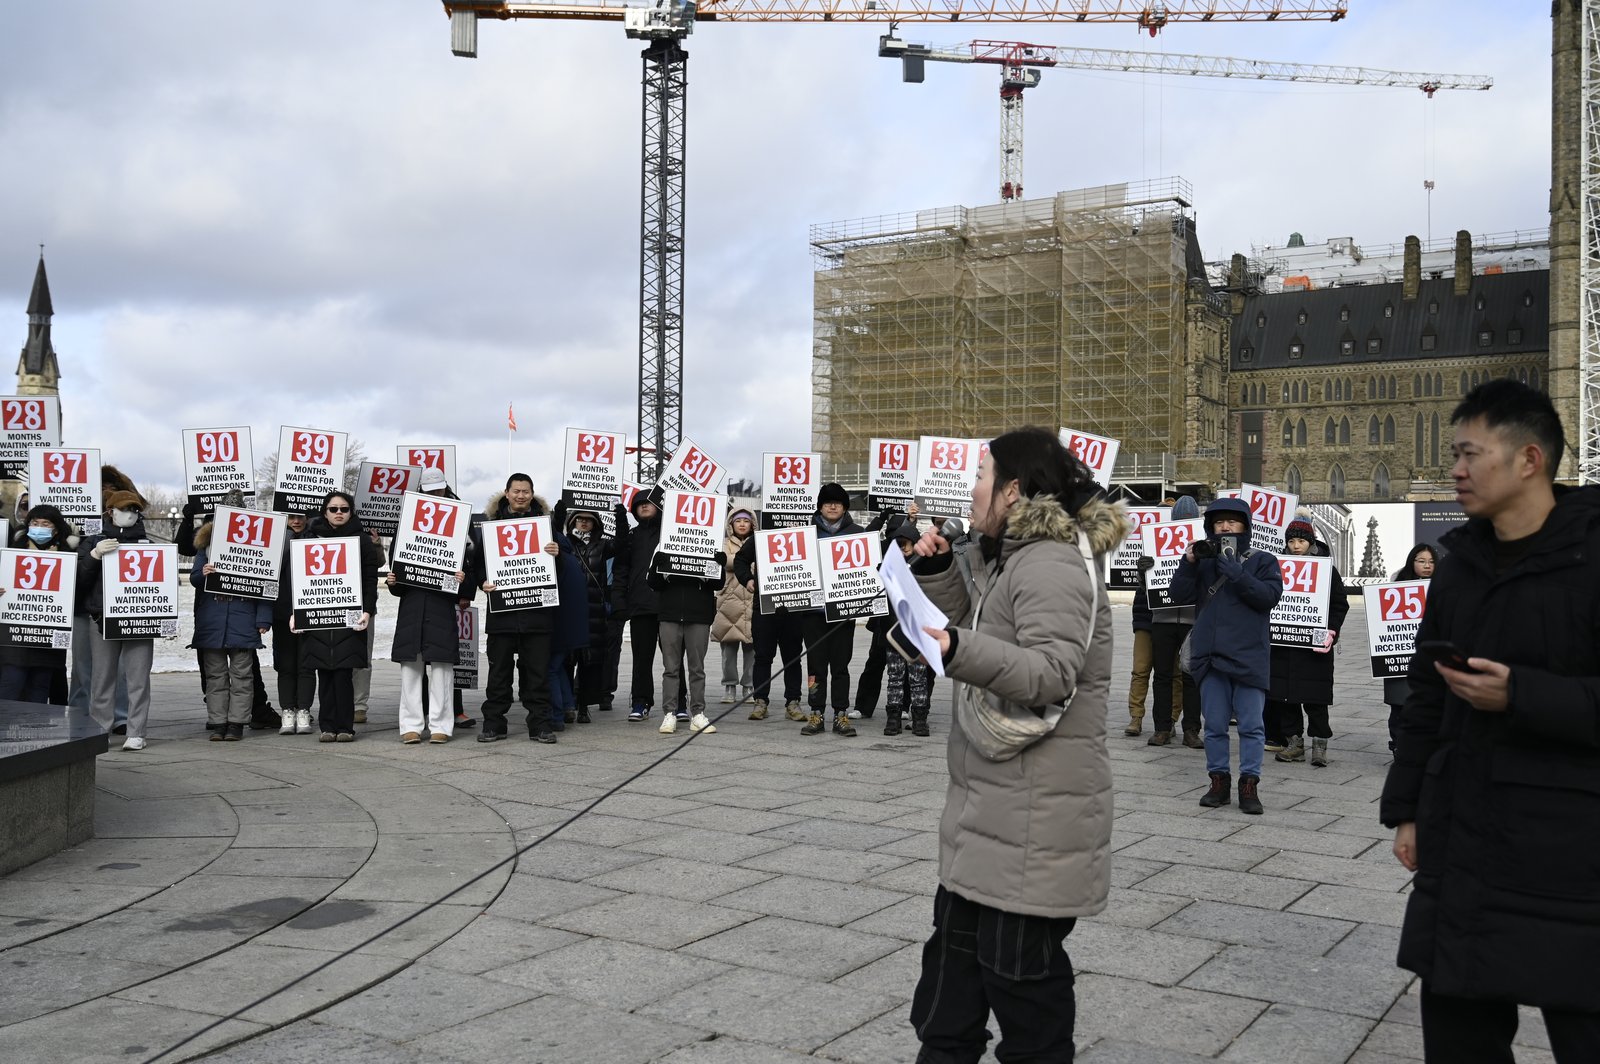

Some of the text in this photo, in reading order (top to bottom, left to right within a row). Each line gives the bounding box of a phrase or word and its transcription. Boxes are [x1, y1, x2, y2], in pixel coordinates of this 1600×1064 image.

[7, 402, 41, 429] 28
[201, 433, 234, 462] 90
[296, 433, 330, 464] 39
[581, 435, 611, 463] 32
[1074, 437, 1102, 468] 30
[882, 444, 905, 470] 19
[934, 442, 964, 470] 33
[49, 454, 82, 482] 37
[295, 466, 326, 475] MONTHS
[684, 451, 713, 483] 30
[778, 458, 806, 484] 33
[286, 474, 317, 482] WAITING
[373, 468, 406, 494] 32
[210, 482, 249, 490] RESPONSE
[584, 482, 618, 490] RESPONSE
[680, 496, 711, 525] 40
[1252, 494, 1281, 525] 20
[418, 501, 454, 536] 37
[232, 514, 268, 546] 31
[1251, 525, 1278, 535] MONTHS
[415, 536, 448, 547] MONTHS
[502, 524, 535, 555] 37
[1159, 526, 1188, 556] 23
[230, 547, 264, 557] MONTHS
[406, 543, 455, 558] WAITING FOR
[772, 533, 802, 562] 31
[836, 539, 866, 569] 20
[220, 554, 254, 564] WAITING
[310, 545, 342, 574] 37
[399, 552, 457, 567] IRCC RESPONSE
[504, 558, 537, 567] MONTHS
[124, 551, 158, 581] 37
[233, 565, 274, 576] RESPONSE
[497, 568, 529, 577] WAITING
[774, 564, 803, 573] MONTHS
[19, 557, 56, 590] 37
[512, 574, 551, 585] RESPONSE
[767, 573, 796, 582] WAITING
[838, 571, 867, 580] MONTHS
[1281, 559, 1312, 592] 34
[231, 577, 264, 586] TIMELINES
[780, 580, 816, 589] RESPONSE
[832, 580, 860, 589] WAITING
[232, 584, 260, 593] RESULTS
[845, 586, 880, 596] RESPONSE
[18, 594, 54, 602] MONTHS
[317, 596, 356, 604] RESPONSE
[1385, 587, 1422, 620] 25
[8, 603, 44, 611] WAITING
[23, 614, 66, 623] RESPONSE
[1282, 613, 1322, 623] RESPONSE
[1375, 644, 1394, 652] IRCC
